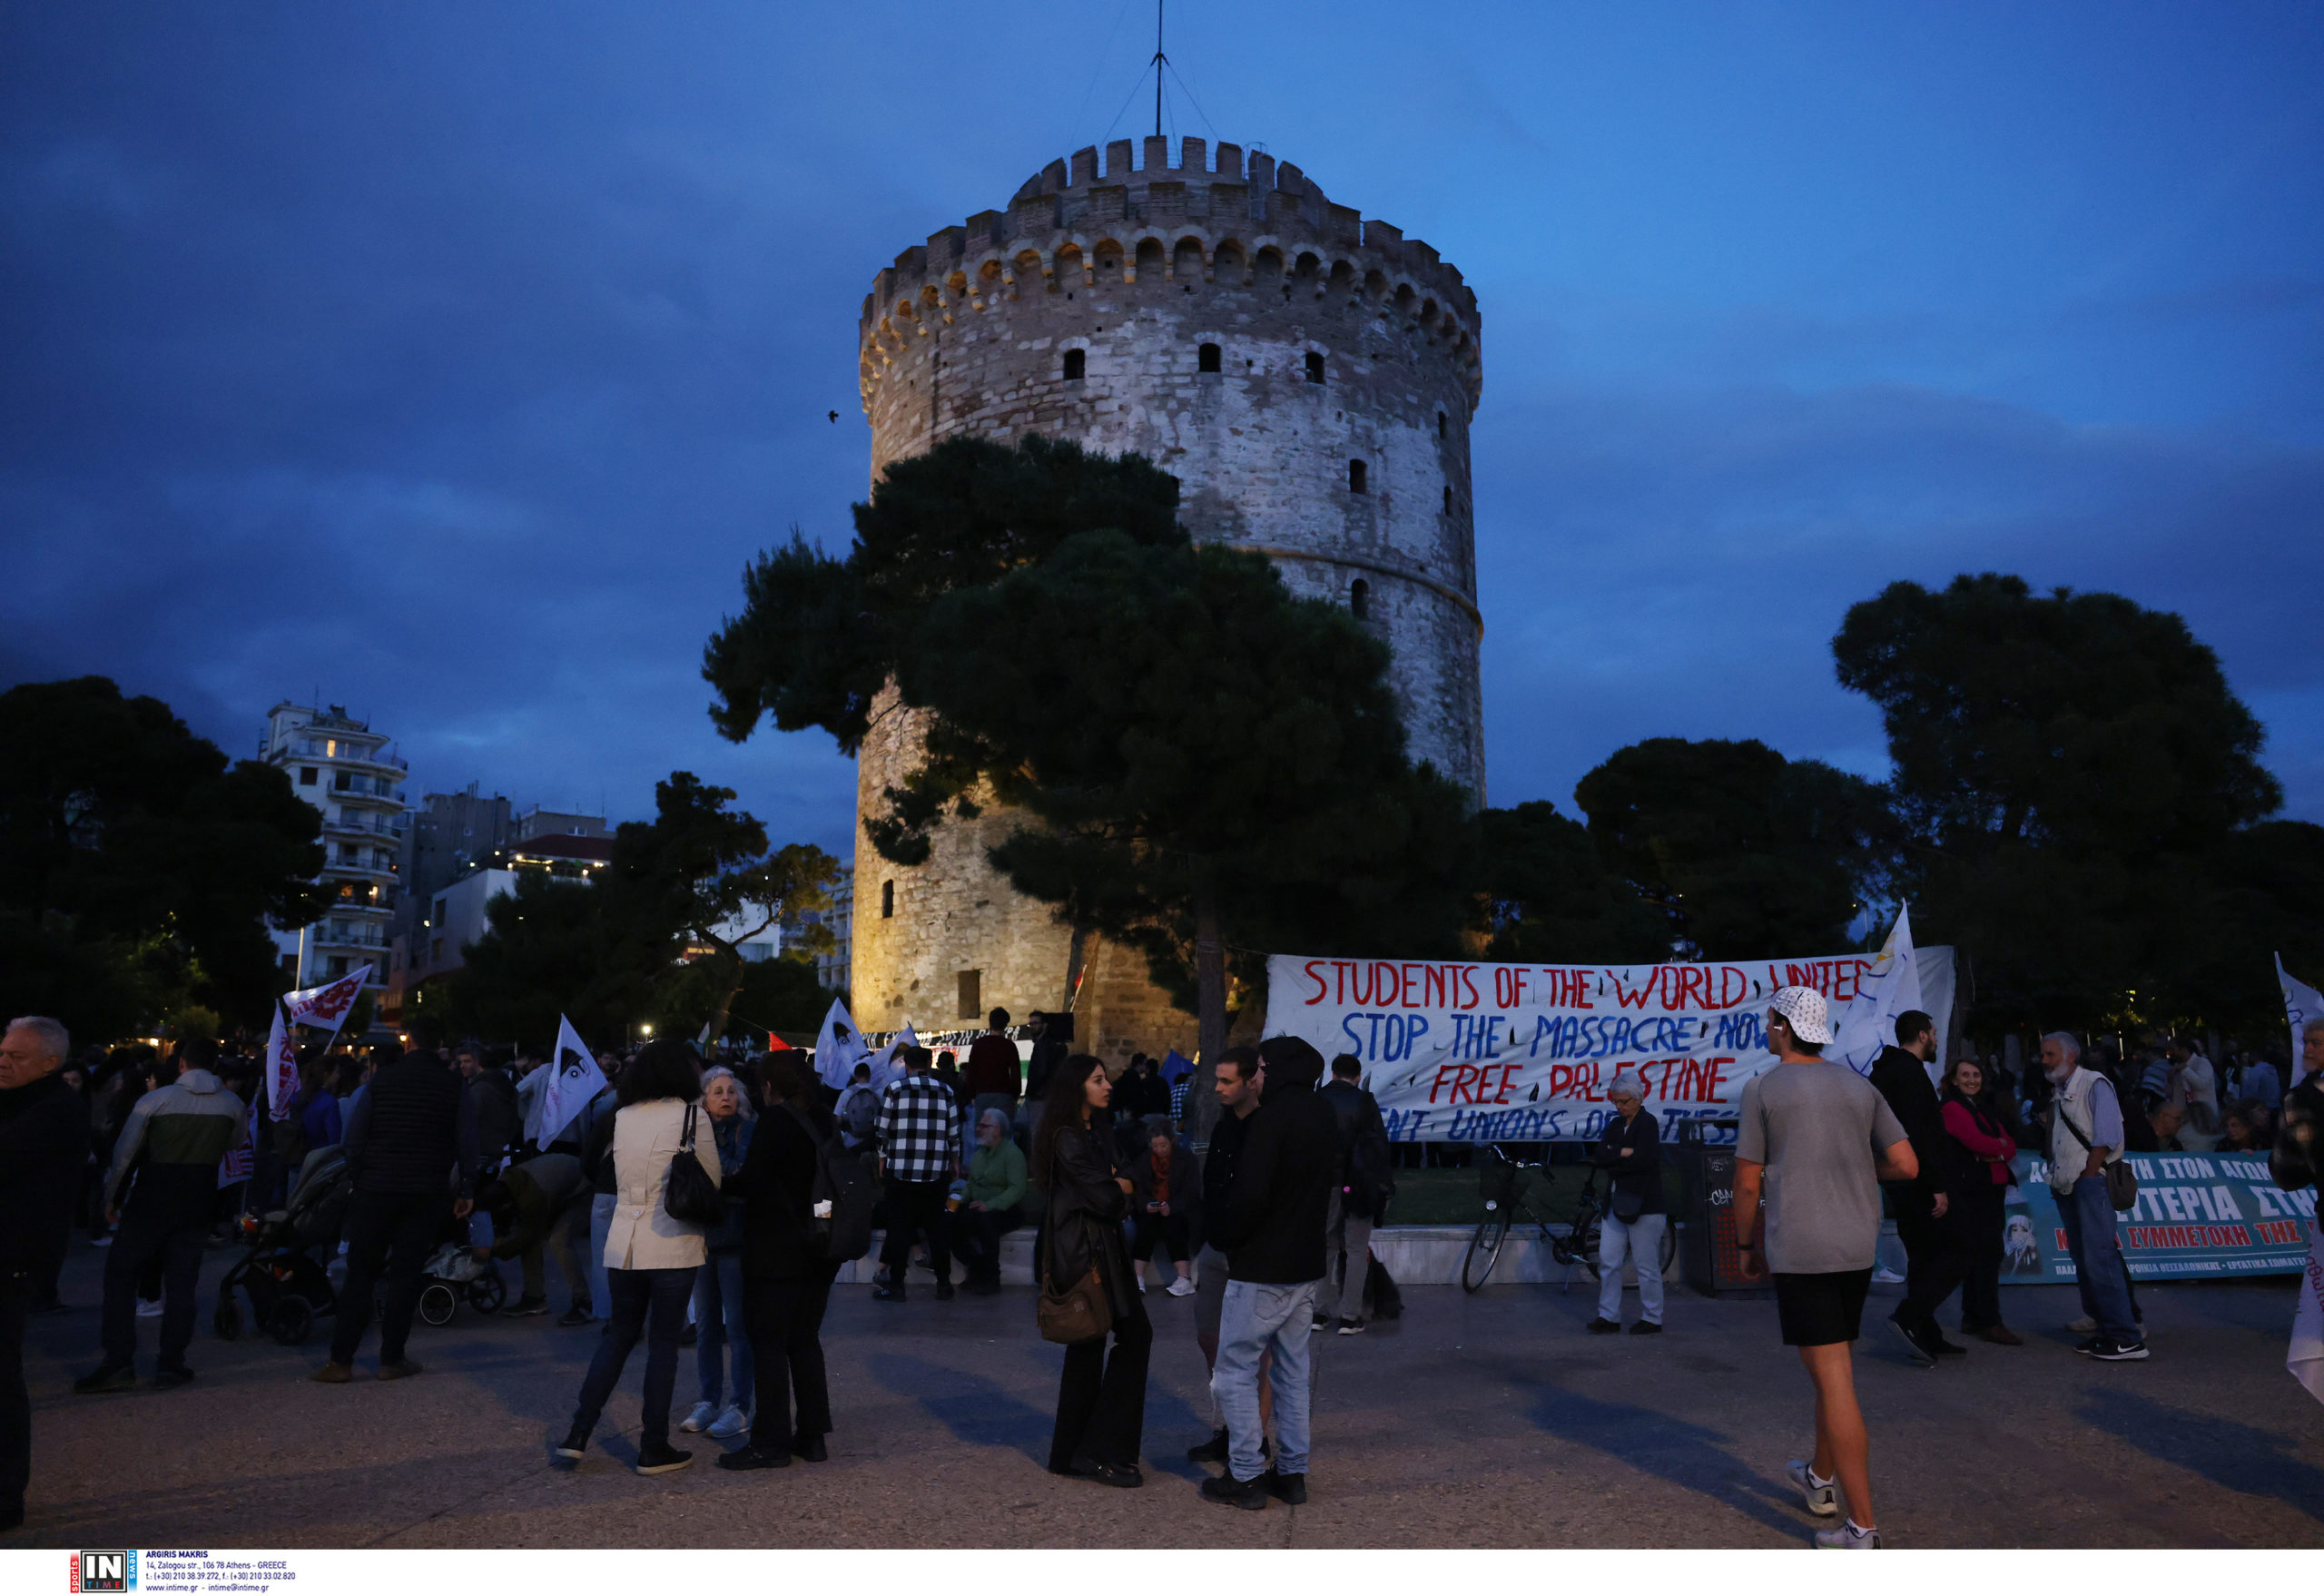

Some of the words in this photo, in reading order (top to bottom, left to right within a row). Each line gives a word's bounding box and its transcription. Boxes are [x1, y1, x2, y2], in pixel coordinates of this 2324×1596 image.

[1305, 960, 1480, 1010] STUDENTS
[1495, 967, 1531, 1008] OF
[1543, 969, 1595, 1009] THE
[1605, 966, 1747, 1010] WORLD
[1342, 1012, 1430, 1062] STOP
[1451, 1013, 1505, 1059] THE
[1530, 1015, 1698, 1059] MASSACRE
[1429, 1064, 1523, 1105] FREE
[1447, 1108, 1570, 1140] UNIONS
[2159, 1158, 2216, 1179] ΣΤΟΝ
[2220, 1159, 2273, 1181] ΑΓΩΝ
[2127, 1225, 2252, 1249] ΣΥΜΜΕΤΟΧΗ
[2254, 1220, 2302, 1246] ΤΗΣ
